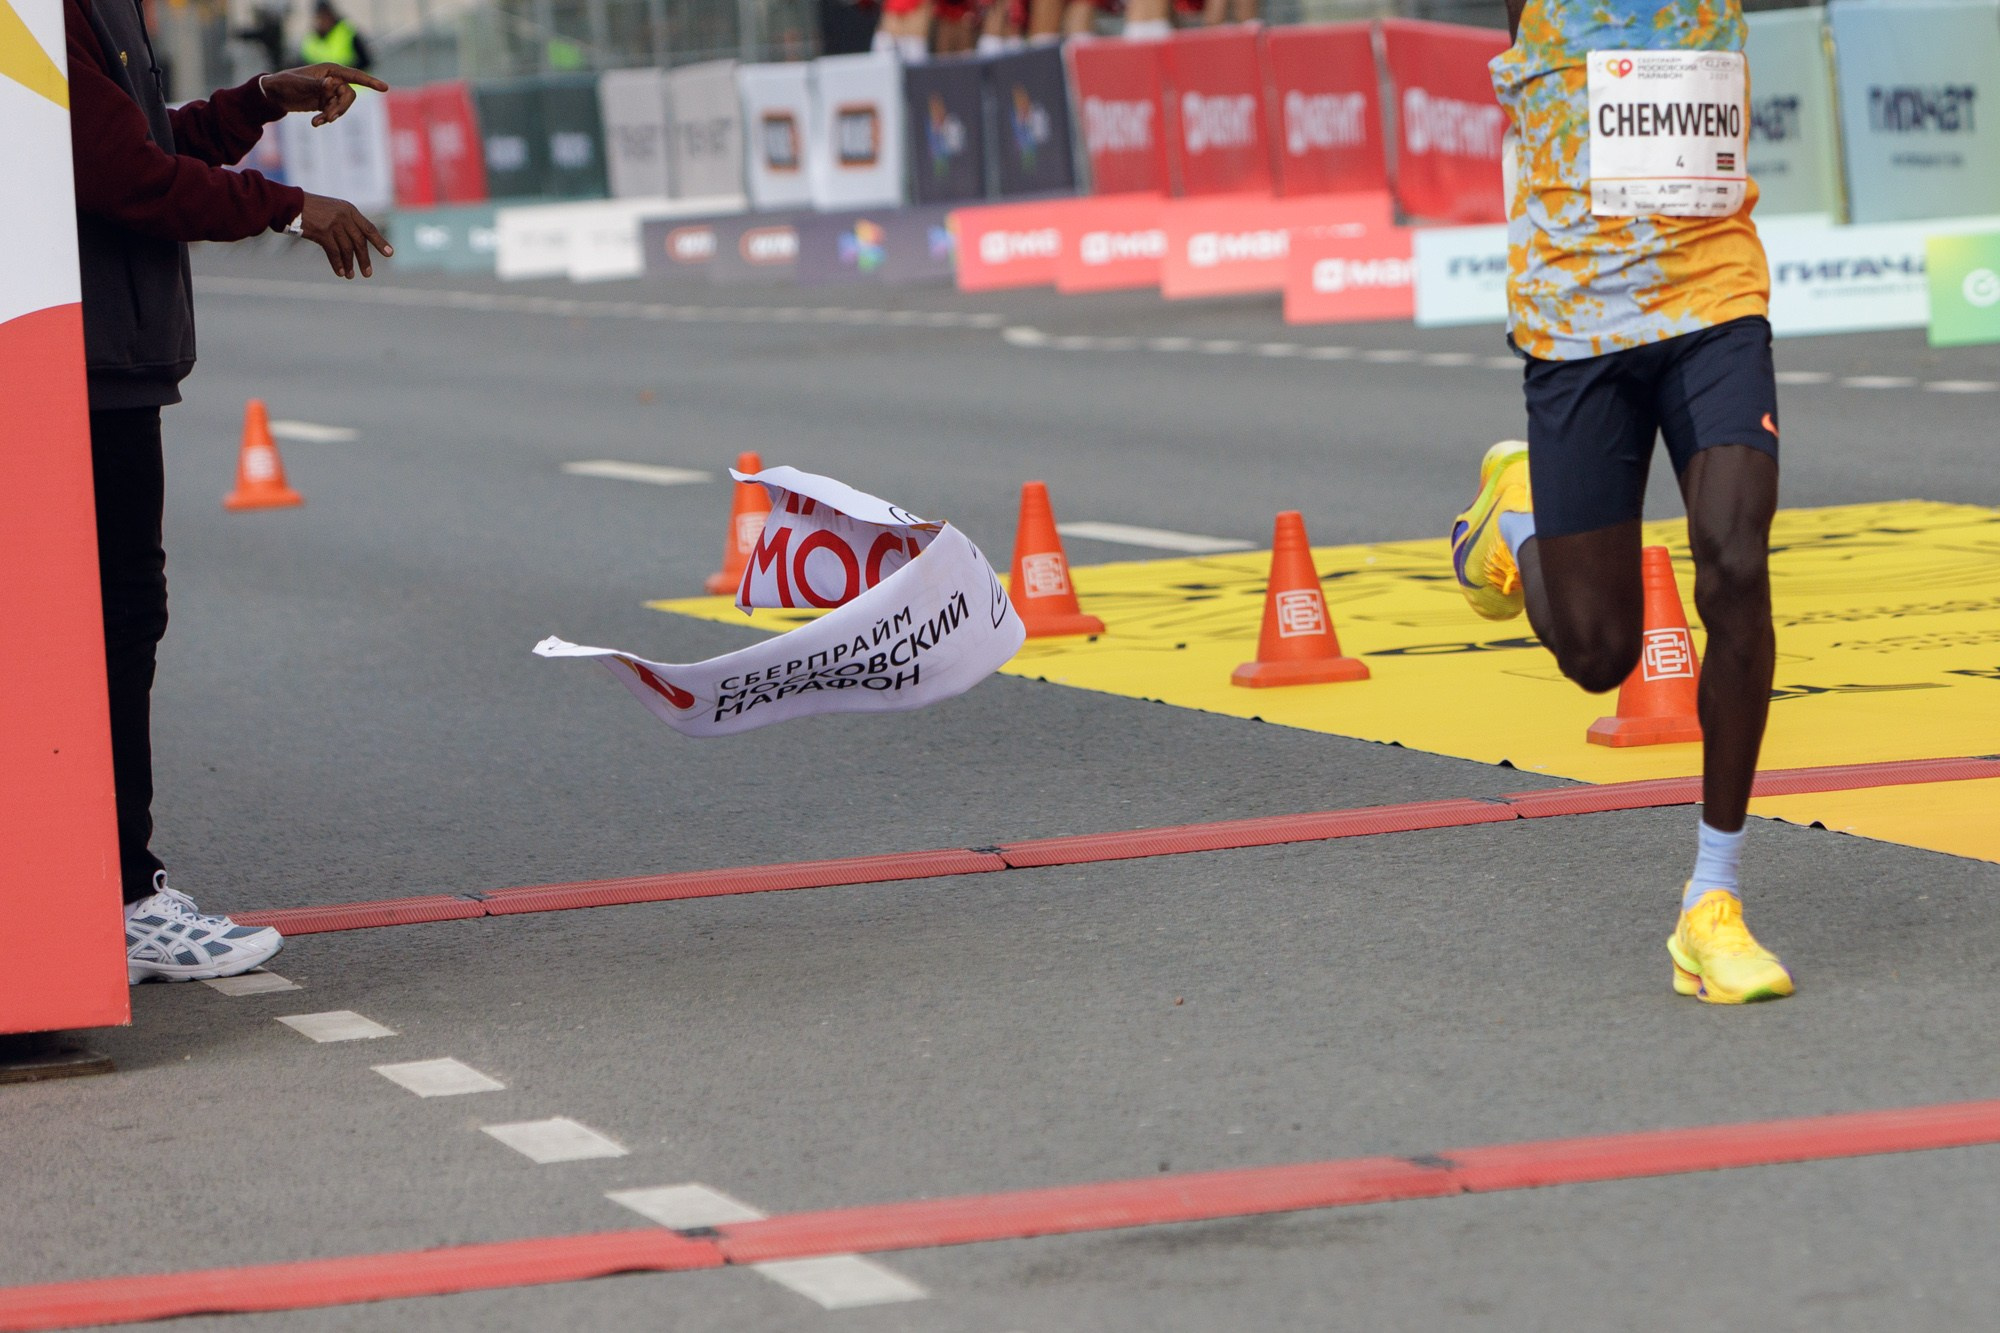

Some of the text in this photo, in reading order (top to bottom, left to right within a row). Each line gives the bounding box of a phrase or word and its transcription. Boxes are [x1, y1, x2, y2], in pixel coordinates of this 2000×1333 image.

[1599, 103, 1740, 137] CHEMWENO
[1676, 155, 1685, 168] 4
[741, 526, 922, 608] МОС
[717, 590, 969, 707] МОСКОВСКИЙ
[720, 605, 912, 690] СБЕРПРАЙМ
[713, 663, 920, 722] МАРАФОН
